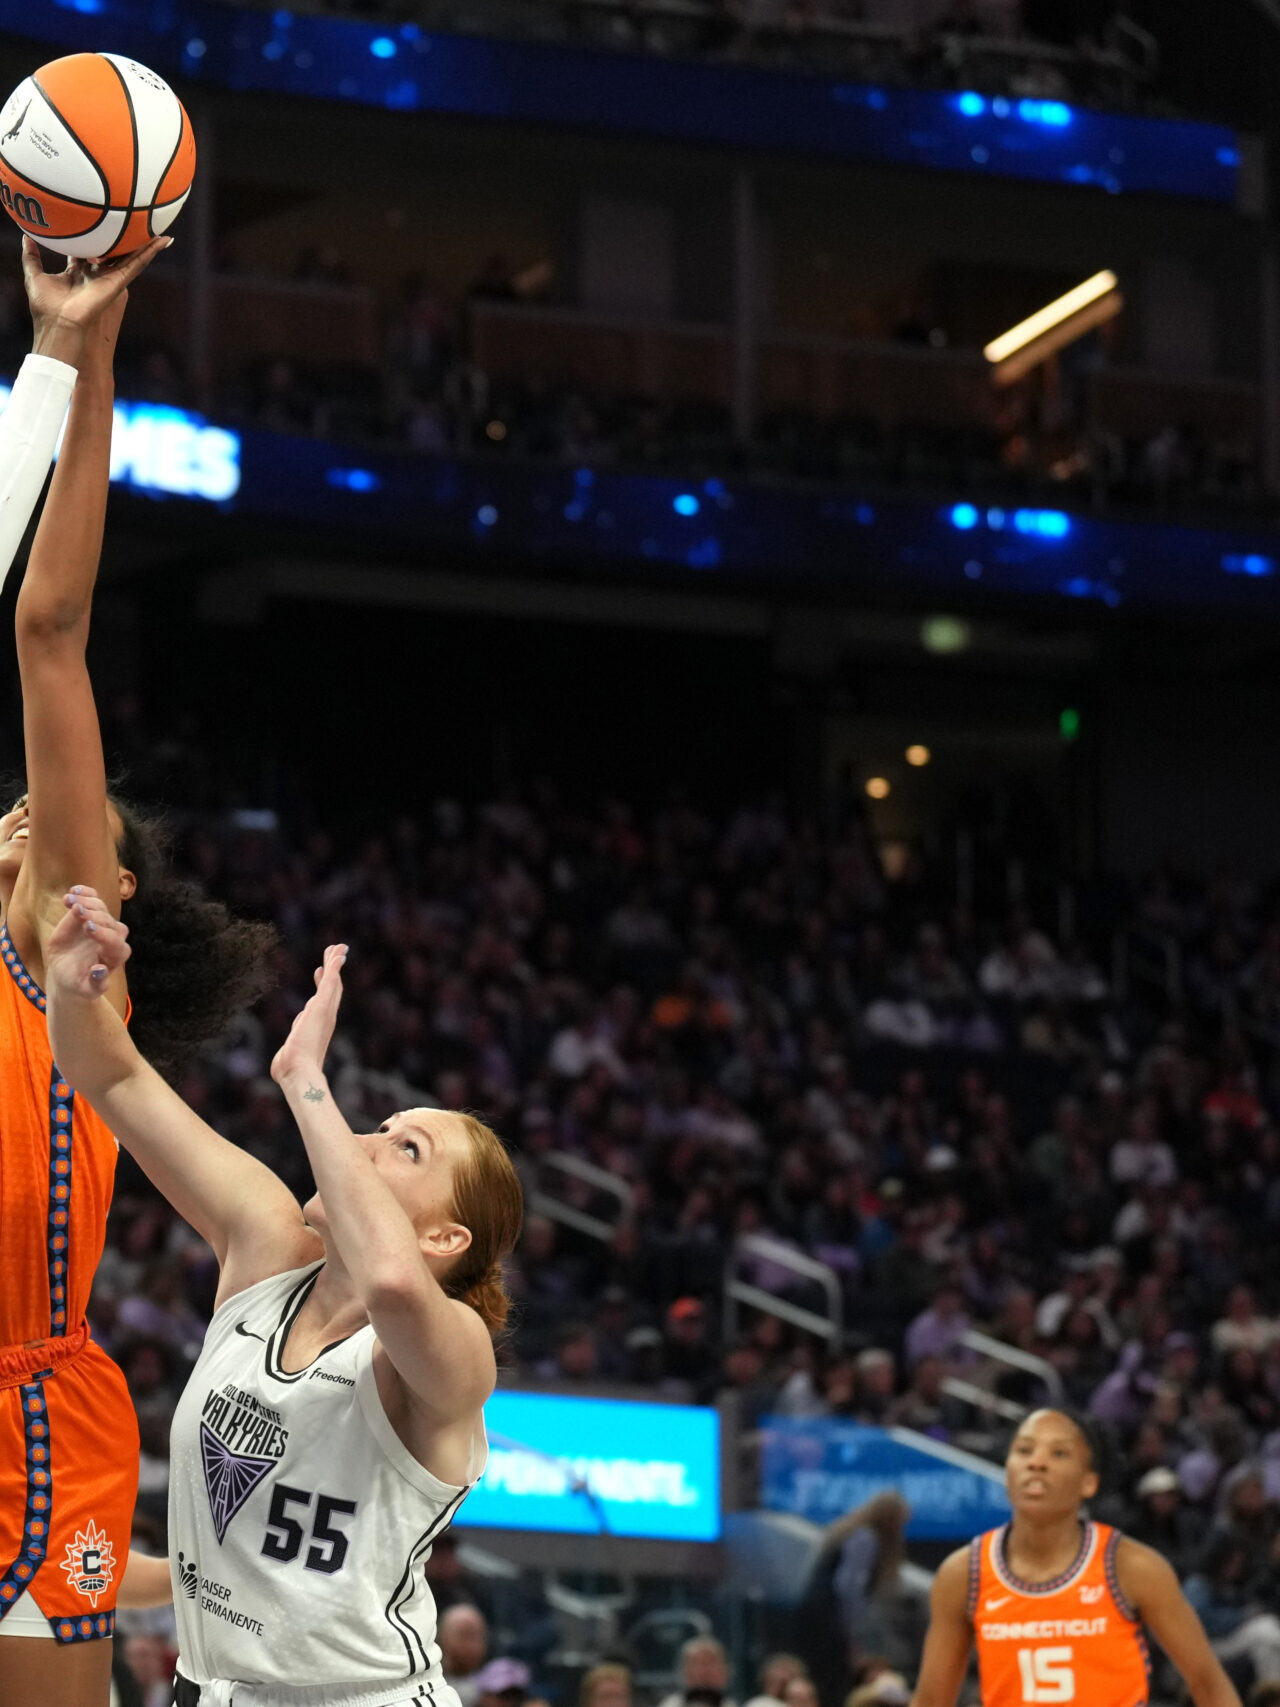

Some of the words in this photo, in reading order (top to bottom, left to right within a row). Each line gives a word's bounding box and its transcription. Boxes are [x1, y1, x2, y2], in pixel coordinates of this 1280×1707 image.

[29, 135, 53, 159] OFFICIAL
[41, 140, 61, 158] GAME
[309, 1367, 356, 1388] freedom
[222, 1383, 260, 1413] GOLDEN
[201, 1388, 289, 1458] VALKYRIES
[260, 1482, 358, 1576] 55
[201, 1595, 265, 1637] ERMANENTE
[980, 1616, 1108, 1641] CONNECTICUT
[1017, 1645, 1075, 1703] 15
